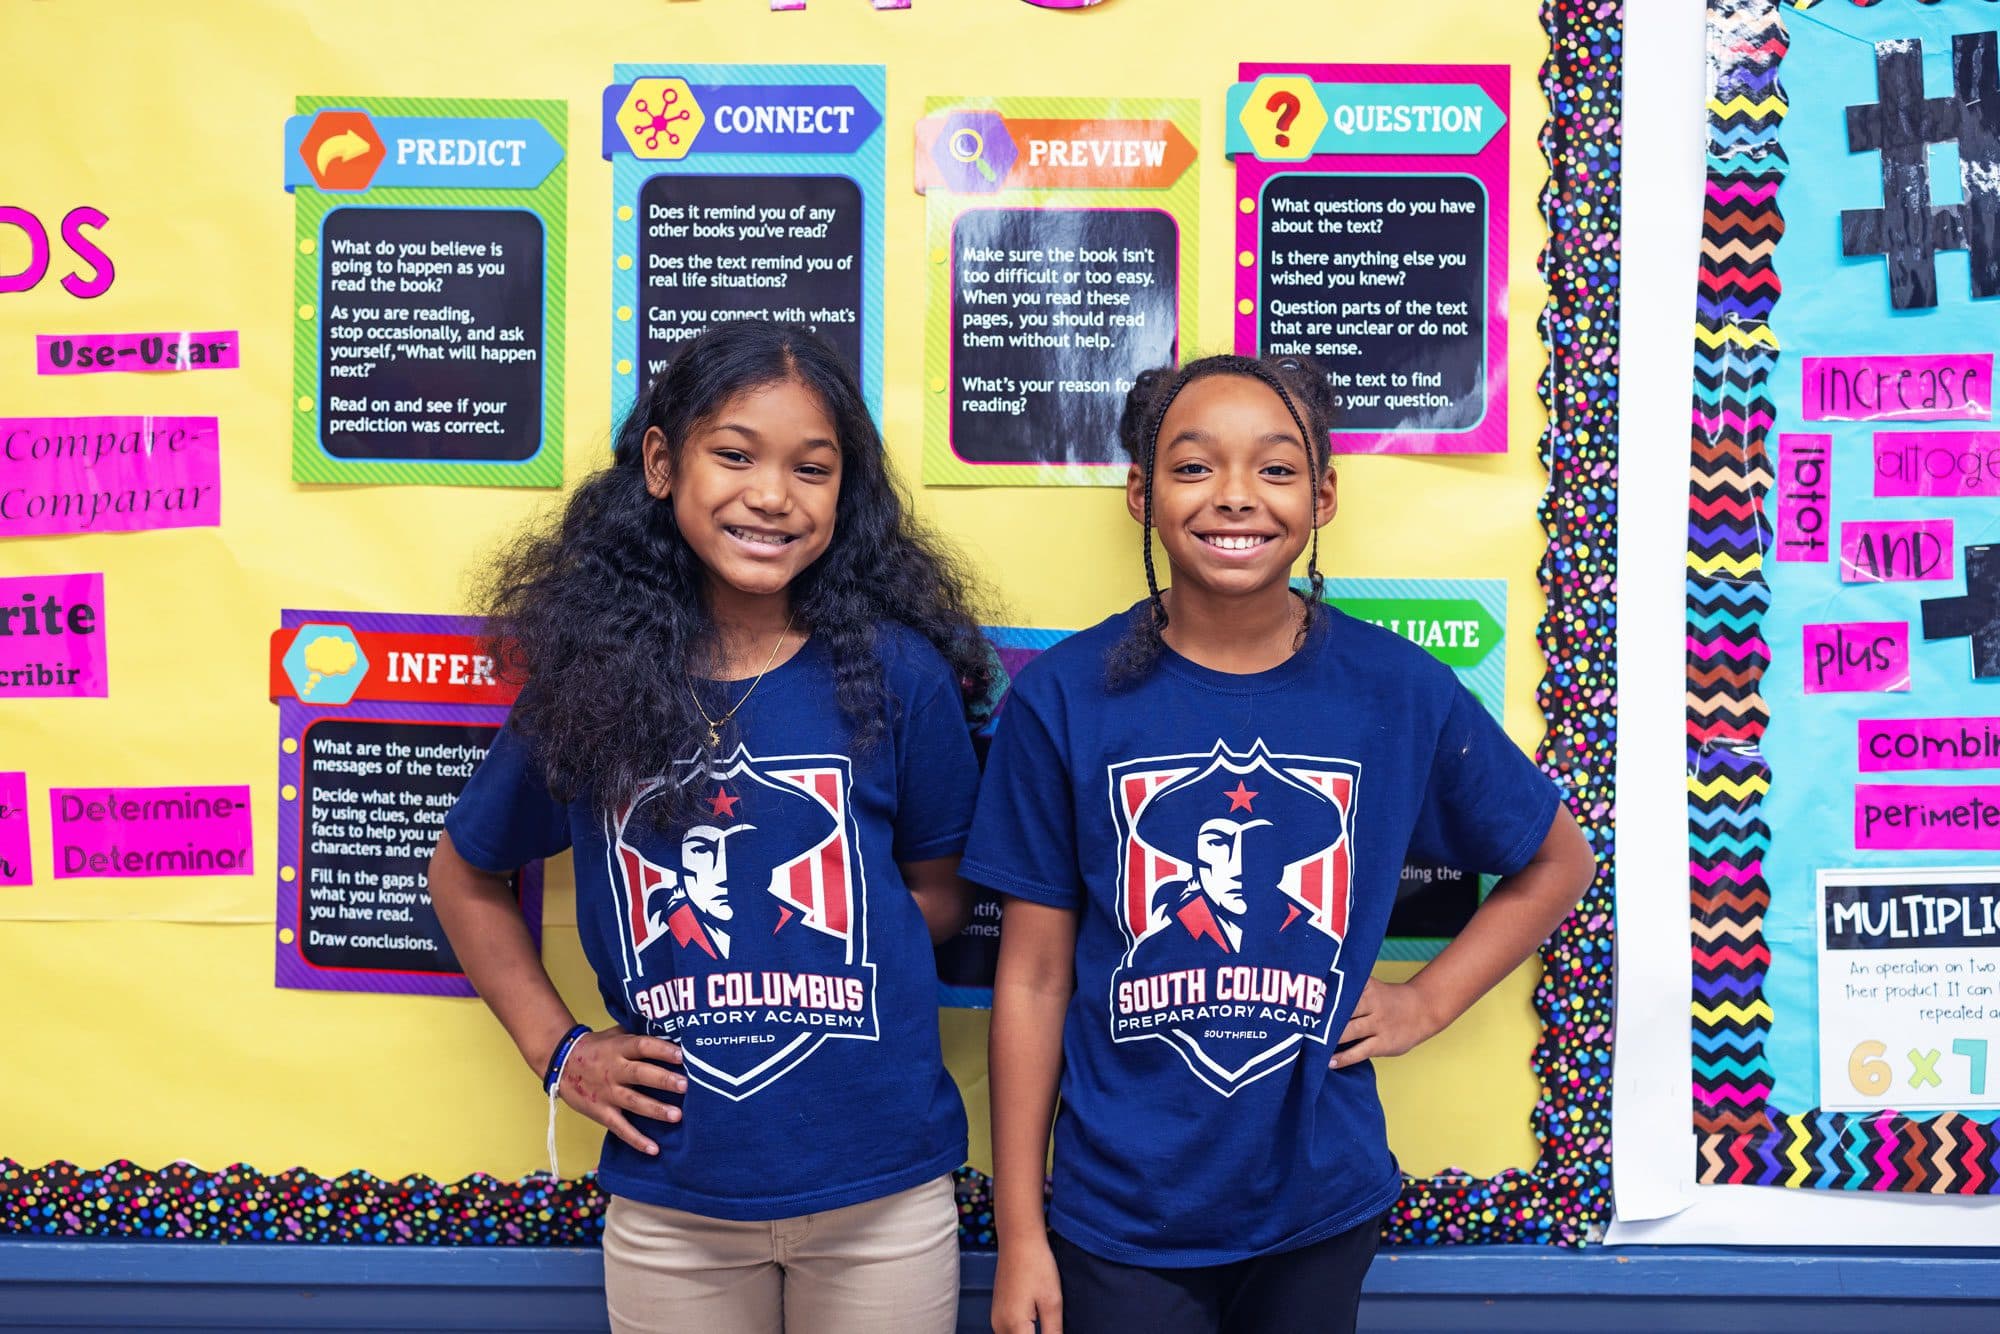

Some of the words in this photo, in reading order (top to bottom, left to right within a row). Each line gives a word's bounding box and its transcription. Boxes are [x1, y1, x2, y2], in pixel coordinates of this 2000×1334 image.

[714, 106, 854, 135] CONNECT
[1334, 105, 1483, 135] QUESTION
[397, 138, 526, 167] PREDICT
[1028, 139, 1168, 168] PREVIEW
[649, 204, 685, 219] Does
[688, 204, 700, 219] it
[704, 204, 756, 220] remind
[759, 208, 786, 223] you
[789, 205, 806, 220] of
[809, 208, 836, 223] any
[1271, 198, 1310, 213] What
[1314, 198, 1384, 216] questions
[1387, 198, 1406, 213] do
[1409, 202, 1436, 217] you
[1440, 198, 1476, 213] have
[649, 222, 690, 237] other
[693, 222, 735, 238] books
[738, 223, 785, 241] you've
[788, 223, 828, 238] read?
[1271, 218, 1314, 233] about
[1318, 218, 1343, 233] the
[1346, 218, 1384, 234] text?
[331, 239, 372, 255] What
[375, 240, 395, 255] do
[398, 243, 426, 258] you
[430, 240, 486, 257] believe
[490, 242, 503, 257] is
[963, 247, 1004, 262] Make
[1009, 250, 1043, 262] sure
[1048, 247, 1075, 262] the
[1080, 247, 1118, 262] book
[1123, 248, 1154, 263] isn't
[331, 258, 372, 277] going
[376, 259, 393, 274] to
[397, 258, 453, 277] happen
[456, 262, 474, 275] as
[477, 263, 505, 278] you
[649, 254, 684, 269] Does
[688, 254, 713, 269] the
[716, 255, 747, 269] text
[751, 254, 803, 270] remind
[806, 258, 833, 273] you
[836, 255, 853, 270] of
[1271, 250, 1284, 265] Is
[1287, 250, 1330, 265] there
[1333, 250, 1399, 269] anything
[1403, 250, 1435, 266] else
[1438, 254, 1466, 269] you
[331, 276, 366, 292] read
[370, 277, 396, 292] the
[400, 277, 443, 293] book?
[649, 272, 678, 287] real
[682, 272, 707, 287] life
[710, 272, 788, 288] situations?
[963, 269, 990, 283] too
[994, 268, 1058, 283] difficult
[1063, 272, 1080, 283] or
[1086, 270, 1112, 284] too
[1116, 272, 1154, 287] easy.
[1270, 270, 1323, 285] wished
[1327, 274, 1355, 289] you
[1359, 270, 1406, 286] knew?
[963, 289, 1007, 304] When
[1012, 293, 1040, 308] you
[1046, 290, 1081, 305] read
[1087, 290, 1130, 305] these
[330, 305, 349, 320] As
[352, 308, 380, 323] you
[383, 308, 410, 321] are
[413, 306, 475, 325] reading,
[1270, 299, 1337, 317] Question
[1342, 301, 1381, 318] parts
[1385, 300, 1402, 315] of
[1406, 300, 1432, 315] the
[1436, 301, 1468, 315] text
[963, 314, 1013, 329] pages,
[1019, 314, 1047, 329] you
[1053, 311, 1104, 326] should
[1109, 311, 1145, 327] read
[1270, 319, 1302, 335] that
[1306, 323, 1332, 335] are
[1336, 320, 1394, 335] unclear
[1397, 323, 1415, 335] or
[1418, 320, 1438, 335] do
[1442, 321, 1468, 335] not
[330, 325, 363, 342] stop
[367, 325, 462, 344] occasionally,
[467, 326, 495, 341] and
[499, 326, 524, 341] ask
[963, 332, 1004, 347] them
[1009, 332, 1070, 348] without
[1075, 333, 1115, 351] help.
[50, 336, 228, 368] Use-Usar
[1270, 340, 1312, 355] make
[1315, 343, 1363, 355] sense.
[1820, 366, 1978, 411] increase
[330, 396, 367, 412] Read
[371, 400, 390, 412] on
[394, 397, 423, 413] and
[426, 401, 453, 413] see
[457, 398, 469, 413] if
[472, 402, 507, 417] your
[963, 397, 1027, 415] reading?
[330, 416, 407, 435] prediction
[411, 421, 441, 433] was
[444, 420, 505, 434] correct.
[6, 428, 200, 469] Compare-
[0, 486, 213, 528] Comparar
[1785, 448, 1826, 550] total
[1815, 629, 1896, 686] plus
[387, 651, 496, 686] INFER
[313, 759, 382, 777] messages
[386, 759, 403, 774] of
[407, 760, 432, 776] the
[436, 762, 474, 777] text?
[61, 791, 245, 822] Determine-
[64, 842, 247, 873] Determinar
[310, 906, 335, 920] you
[339, 904, 373, 920] have
[377, 907, 413, 922] read.
[310, 930, 347, 946] Draw
[350, 934, 438, 951] conclusions.
[1850, 961, 1870, 975] An
[1876, 959, 1939, 979] operation
[1945, 963, 1964, 973] on
[1970, 957, 1996, 974] two
[706, 971, 864, 1012] COLUMBUS
[1118, 968, 1207, 1014] SOUTH
[1845, 984, 1878, 999] their
[1947, 981, 1960, 997] It
[1967, 985, 1993, 996] can
[764, 1010, 865, 1029] ACADEMY
[1118, 1004, 1256, 1031] PREPARATORY
[1919, 1004, 1984, 1025] repeated
[695, 1034, 776, 1046] SOUTHFIELD
[1203, 1029, 1268, 1040] SOUTHFIELD
[1848, 1039, 1893, 1097] 6
[1952, 1038, 1988, 1095] 7
